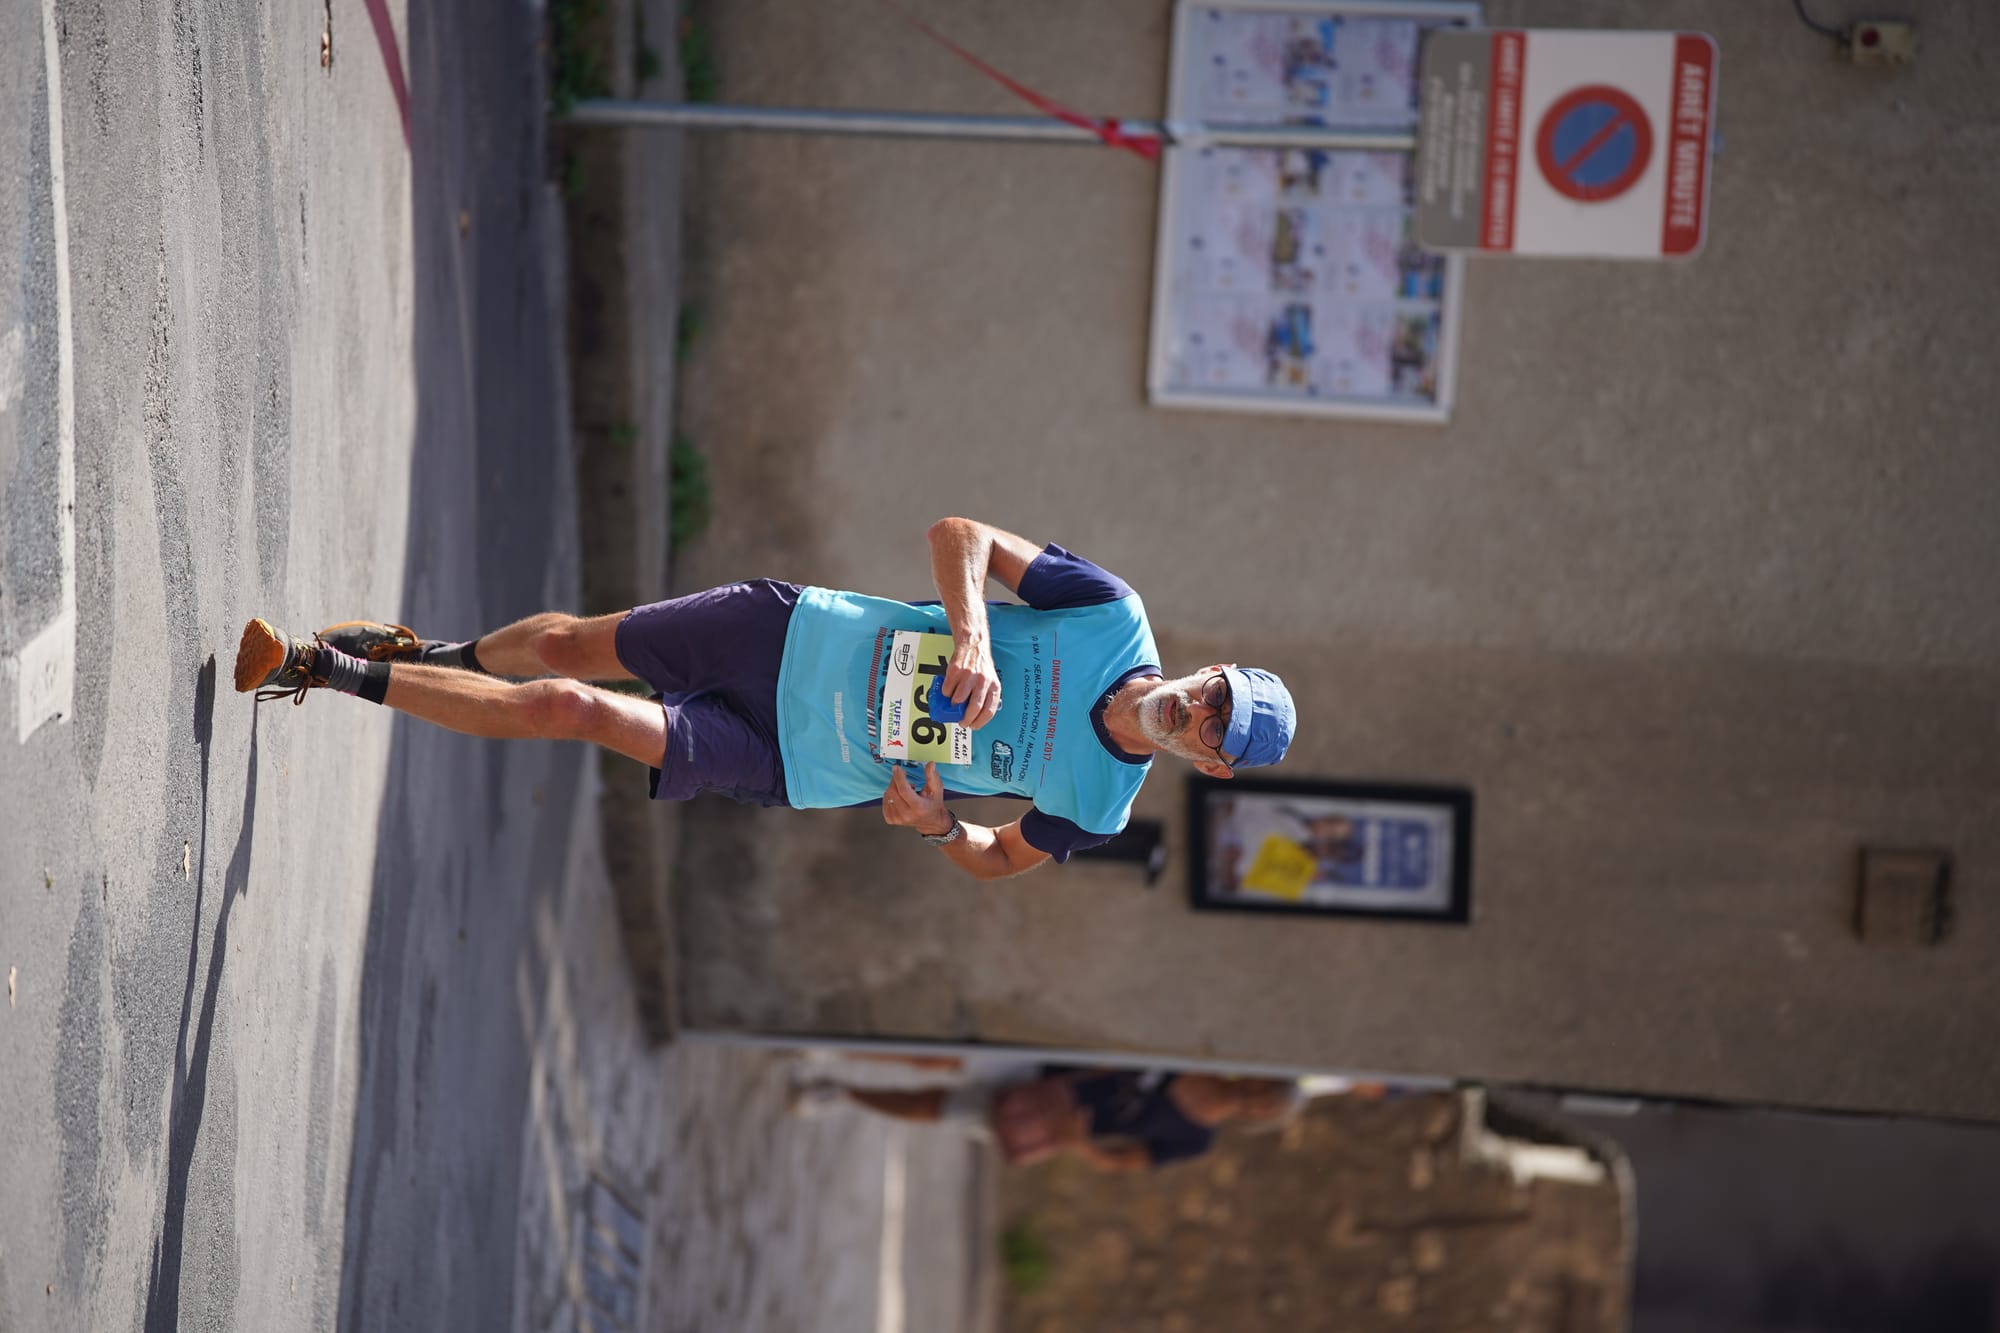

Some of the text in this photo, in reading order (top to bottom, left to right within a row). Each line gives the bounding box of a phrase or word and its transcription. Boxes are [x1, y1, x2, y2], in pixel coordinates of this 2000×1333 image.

[1669, 62, 1708, 231] ARRÊT MINUTE
[900, 644, 910, 671] BFP
[1032, 643, 1040, 654] KM
[893, 699, 902, 736] TUFF'S
[1023, 702, 1030, 710] SA
[1030, 664, 1042, 733] SEMI-MARATHON
[1042, 659, 1061, 761] DIMANCHE 30 AVRIL 2017
[887, 701, 895, 740] Aventure
[1016, 712, 1028, 744] DISTANCE
[1017, 742, 1034, 782] MARATHON
